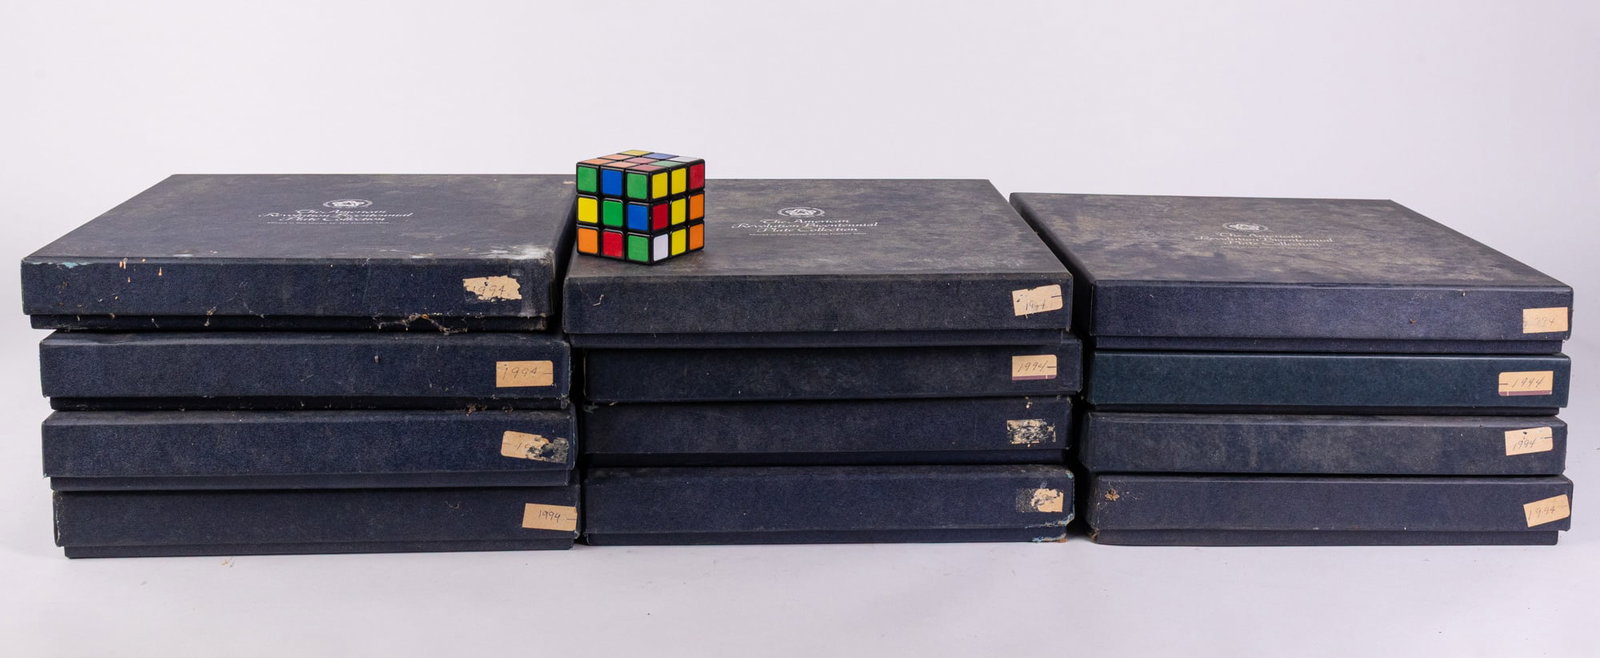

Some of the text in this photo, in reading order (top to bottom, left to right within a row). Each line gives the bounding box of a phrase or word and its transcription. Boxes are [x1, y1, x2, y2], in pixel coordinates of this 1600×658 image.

[501, 364, 538, 381] 1994
[1016, 360, 1049, 373] 1994
[537, 510, 561, 523] 1994
